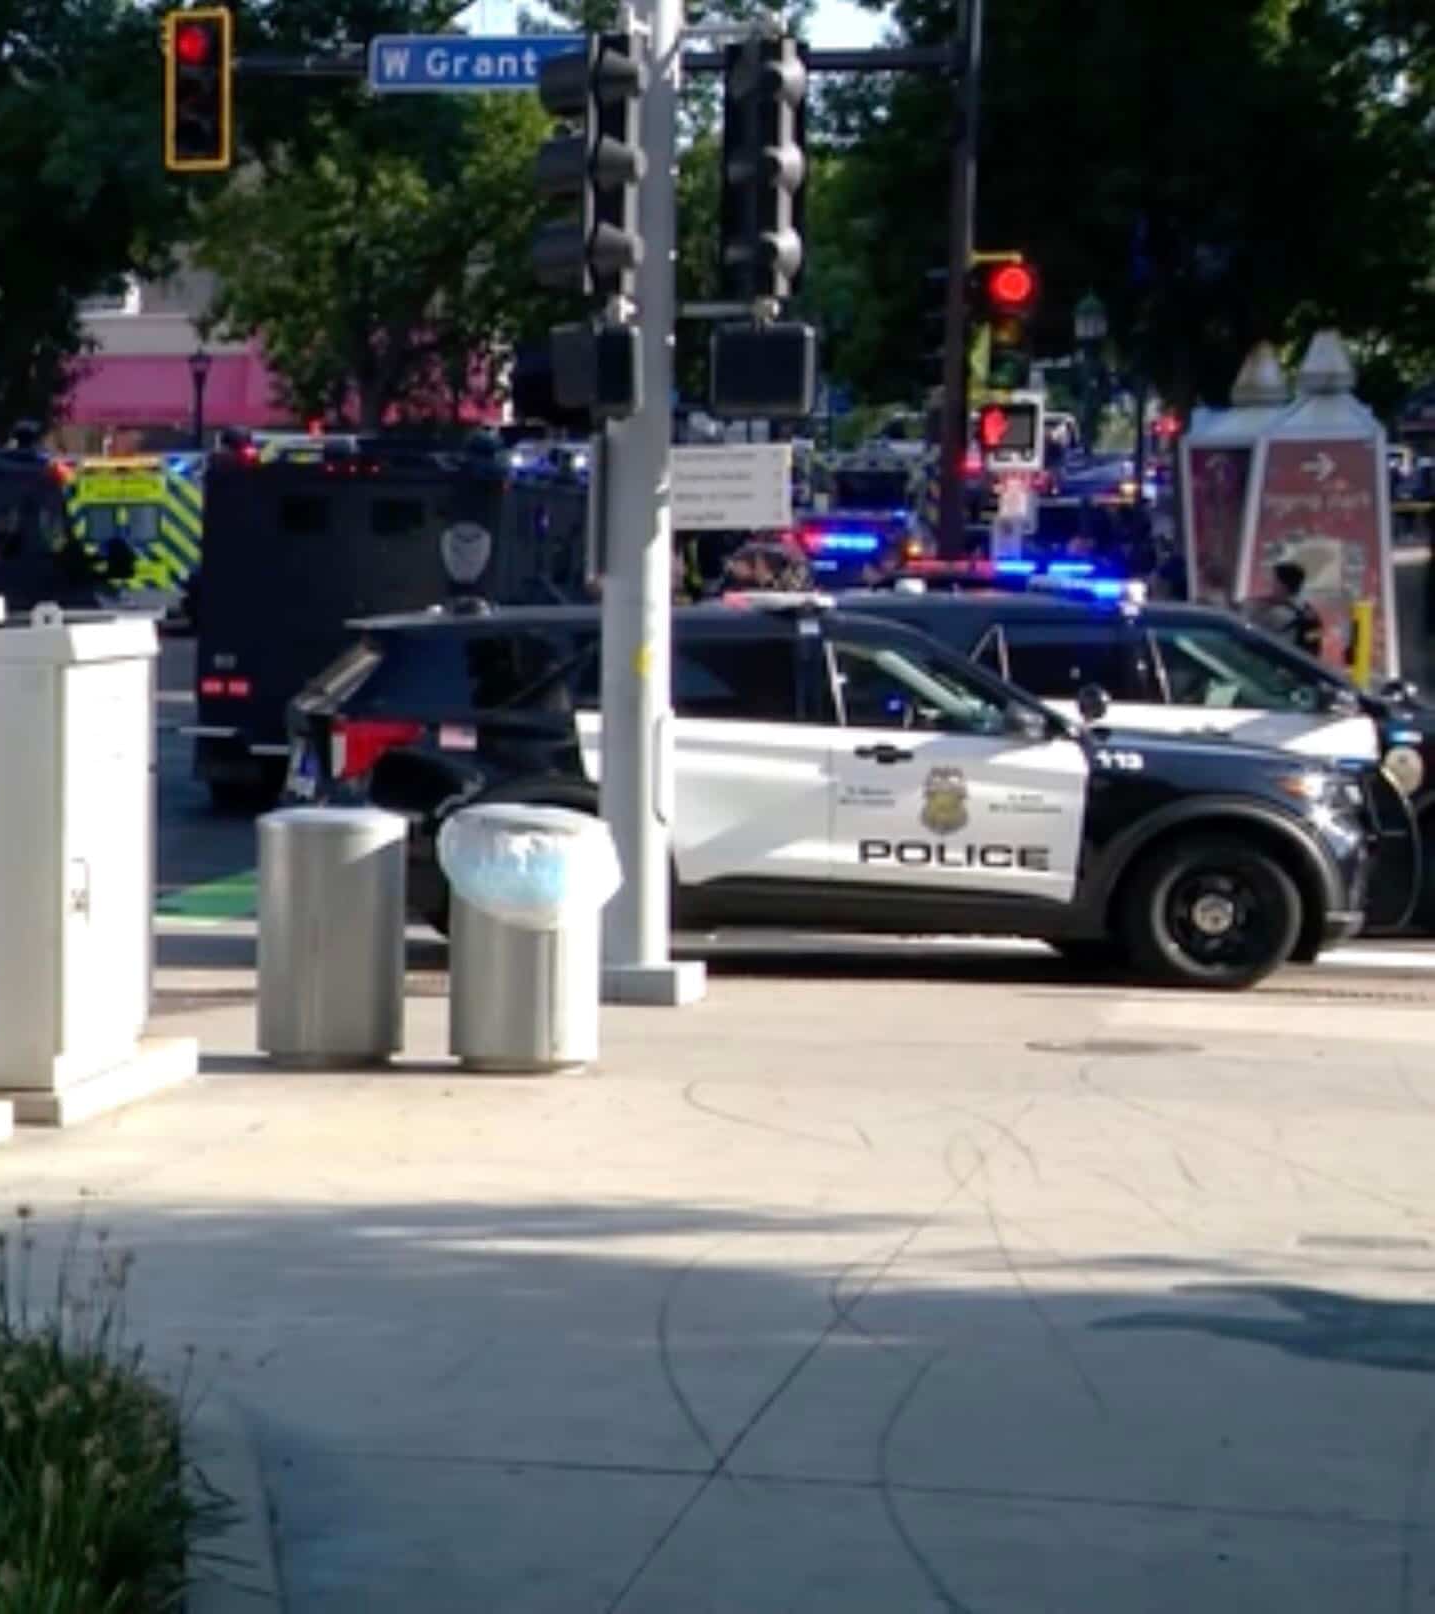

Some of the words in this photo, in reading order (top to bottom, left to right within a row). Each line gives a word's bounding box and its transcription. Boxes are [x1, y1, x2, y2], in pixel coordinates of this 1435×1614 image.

[381, 46, 410, 79] W
[425, 46, 538, 78] Grant
[859, 839, 1049, 871] POLICE
